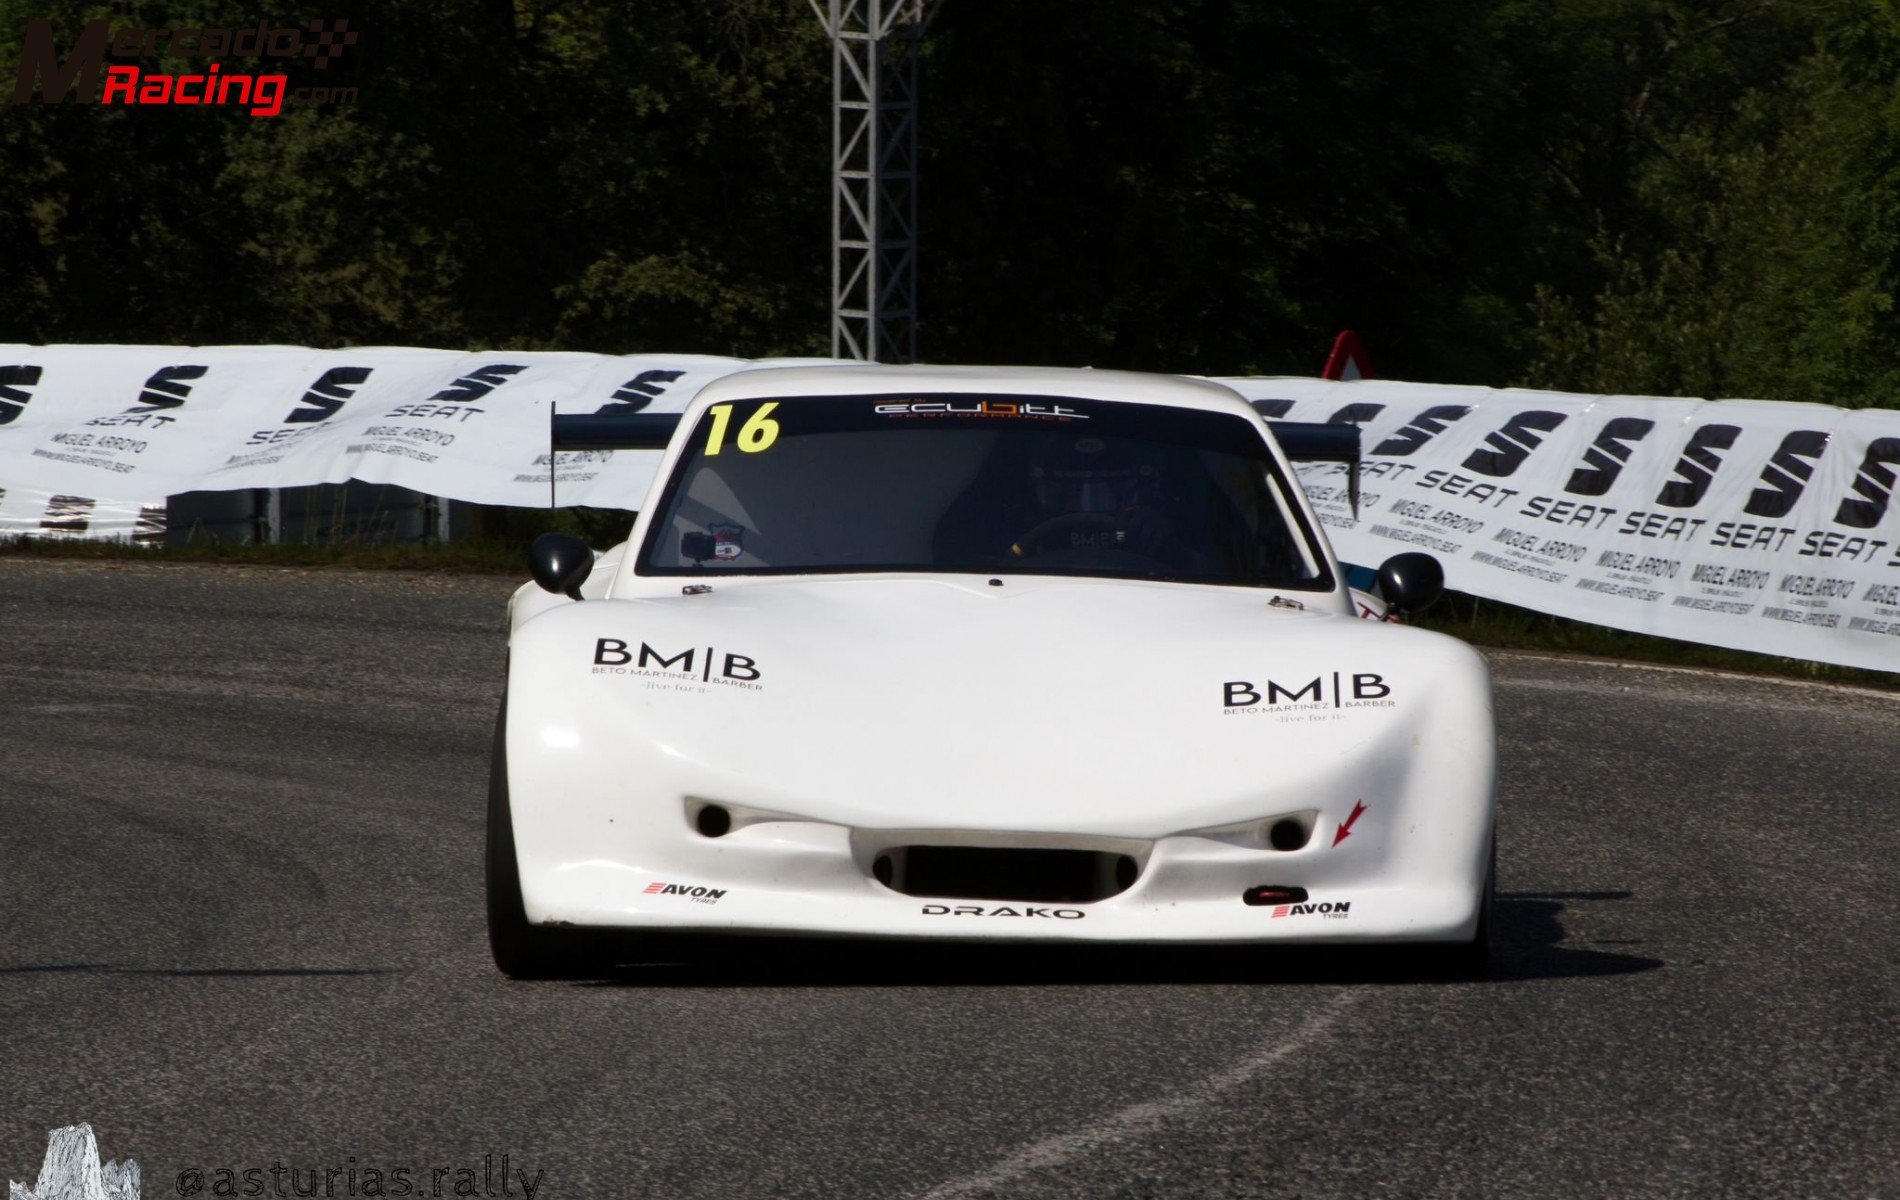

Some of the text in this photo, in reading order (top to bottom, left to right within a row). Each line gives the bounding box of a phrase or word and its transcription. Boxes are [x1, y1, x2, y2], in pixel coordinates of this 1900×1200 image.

[384, 404, 485, 422] SEAT
[704, 402, 780, 456] 16
[1415, 470, 1519, 508] SEAT
[1519, 496, 1617, 530] SEAT
[1618, 510, 1707, 542] SEAT
[1710, 522, 1796, 552] SEAT
[1798, 530, 1888, 563] SEAT
[630, 669, 698, 681] MARTINEZ
[712, 677, 763, 691] BARBER
[1223, 700, 1396, 715] BETO MARTINEZ BARBER
[660, 883, 727, 899] AVON
[922, 904, 1086, 920] DRAKO
[1289, 902, 1351, 916] AVON
